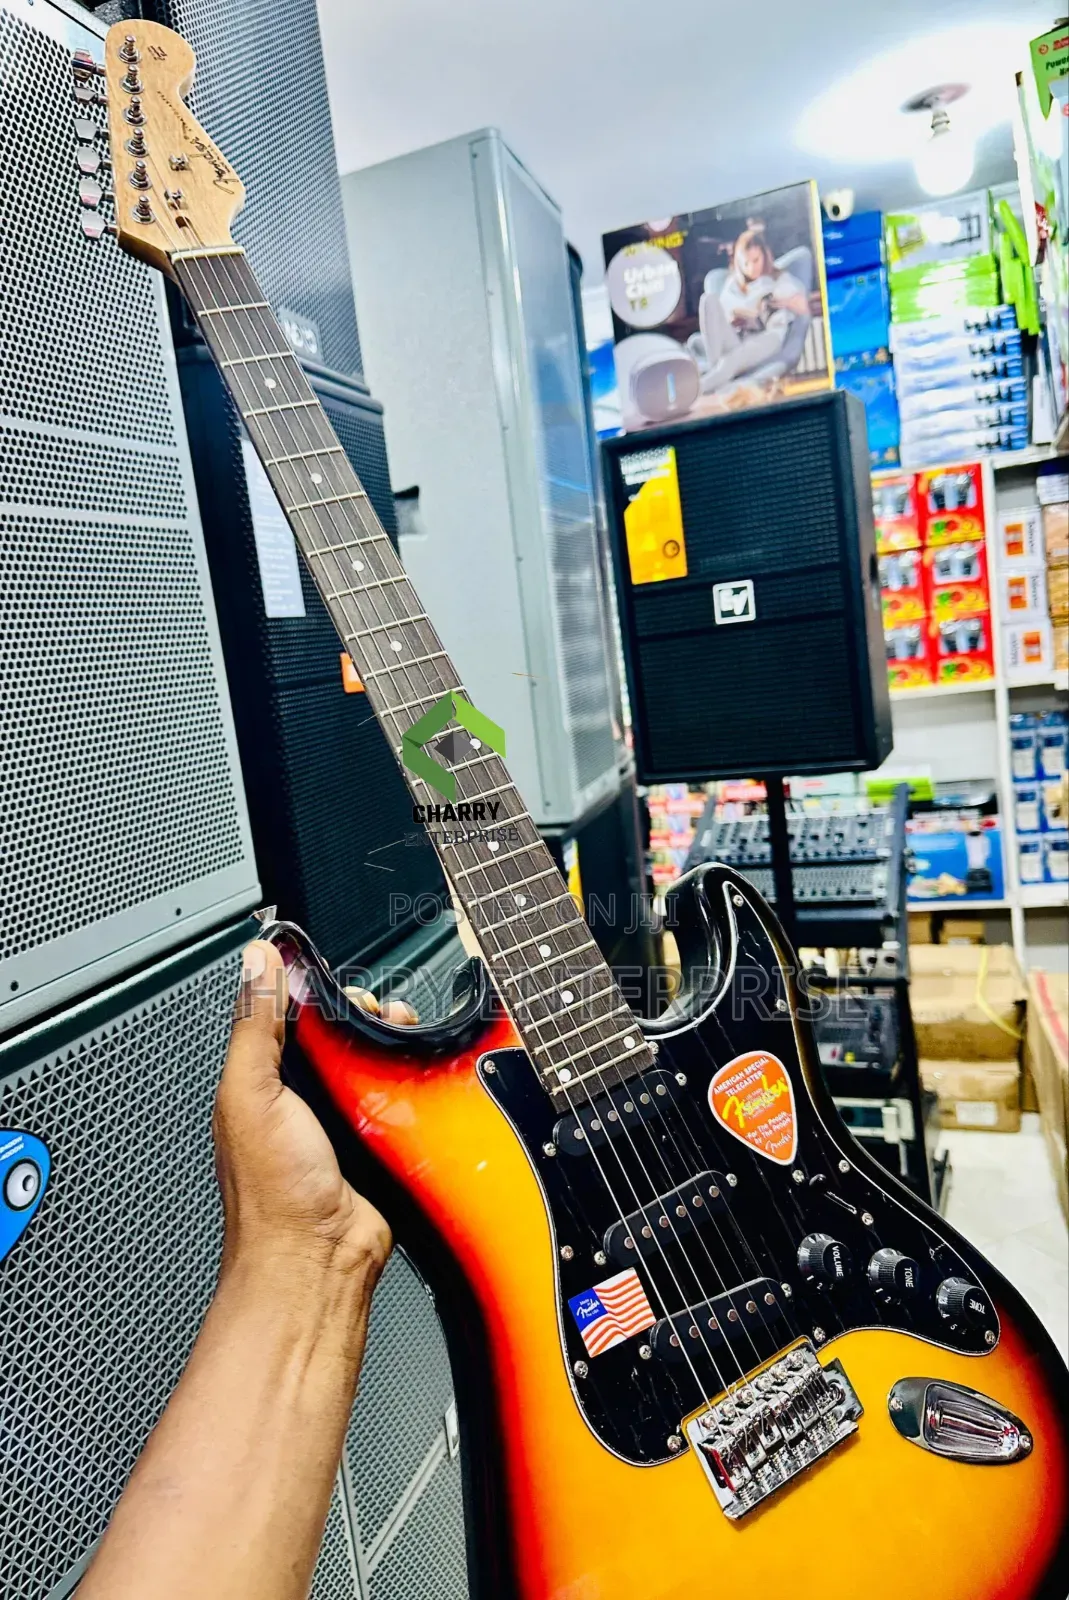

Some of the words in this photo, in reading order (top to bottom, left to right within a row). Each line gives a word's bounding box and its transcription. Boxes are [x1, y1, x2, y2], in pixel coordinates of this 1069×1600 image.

[713, 1070, 745, 1095] AMERICAN
[744, 1056, 770, 1076] SPECIAL
[832, 1245, 844, 1277] VOLUME
[904, 1267, 914, 1288] TONE
[969, 1298, 986, 1315] TONE
